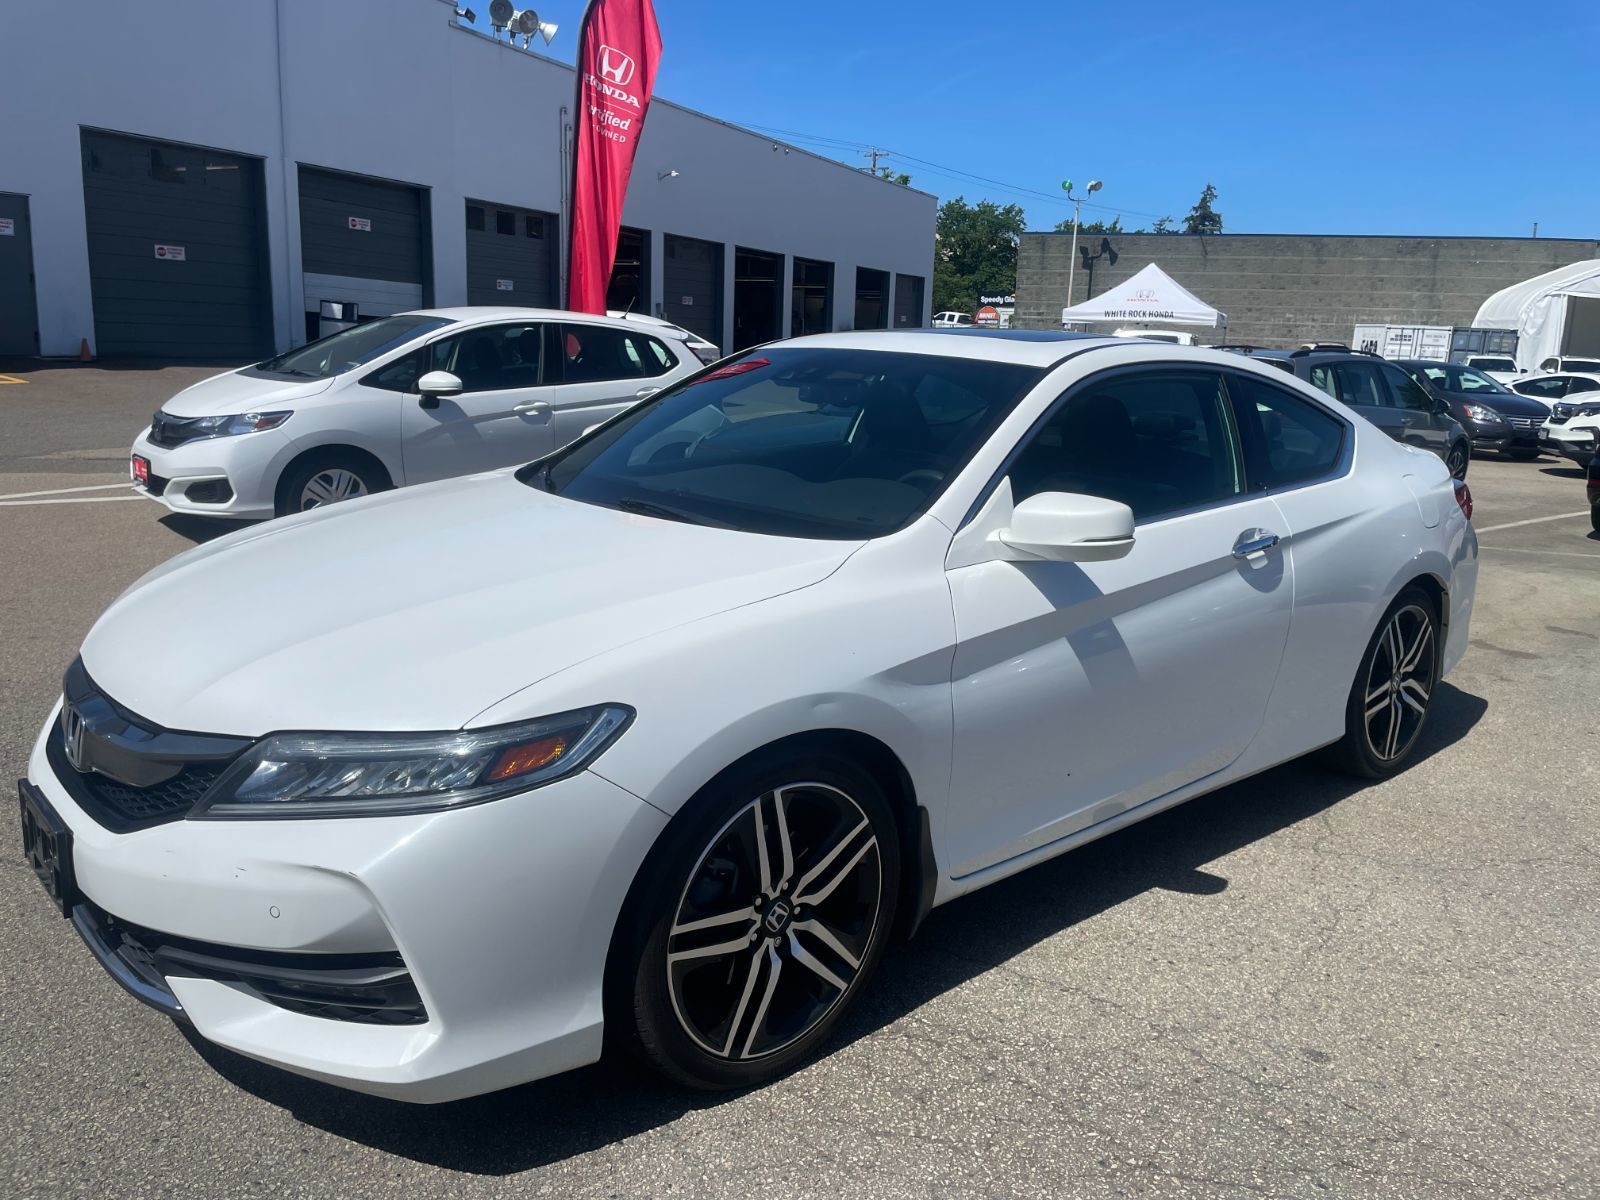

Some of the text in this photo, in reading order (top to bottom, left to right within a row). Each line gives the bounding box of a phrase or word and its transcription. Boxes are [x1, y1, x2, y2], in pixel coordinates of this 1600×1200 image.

[980, 295, 1003, 305] Speedy
[1104, 310, 1174, 319] WHITE ROCK HONDA
